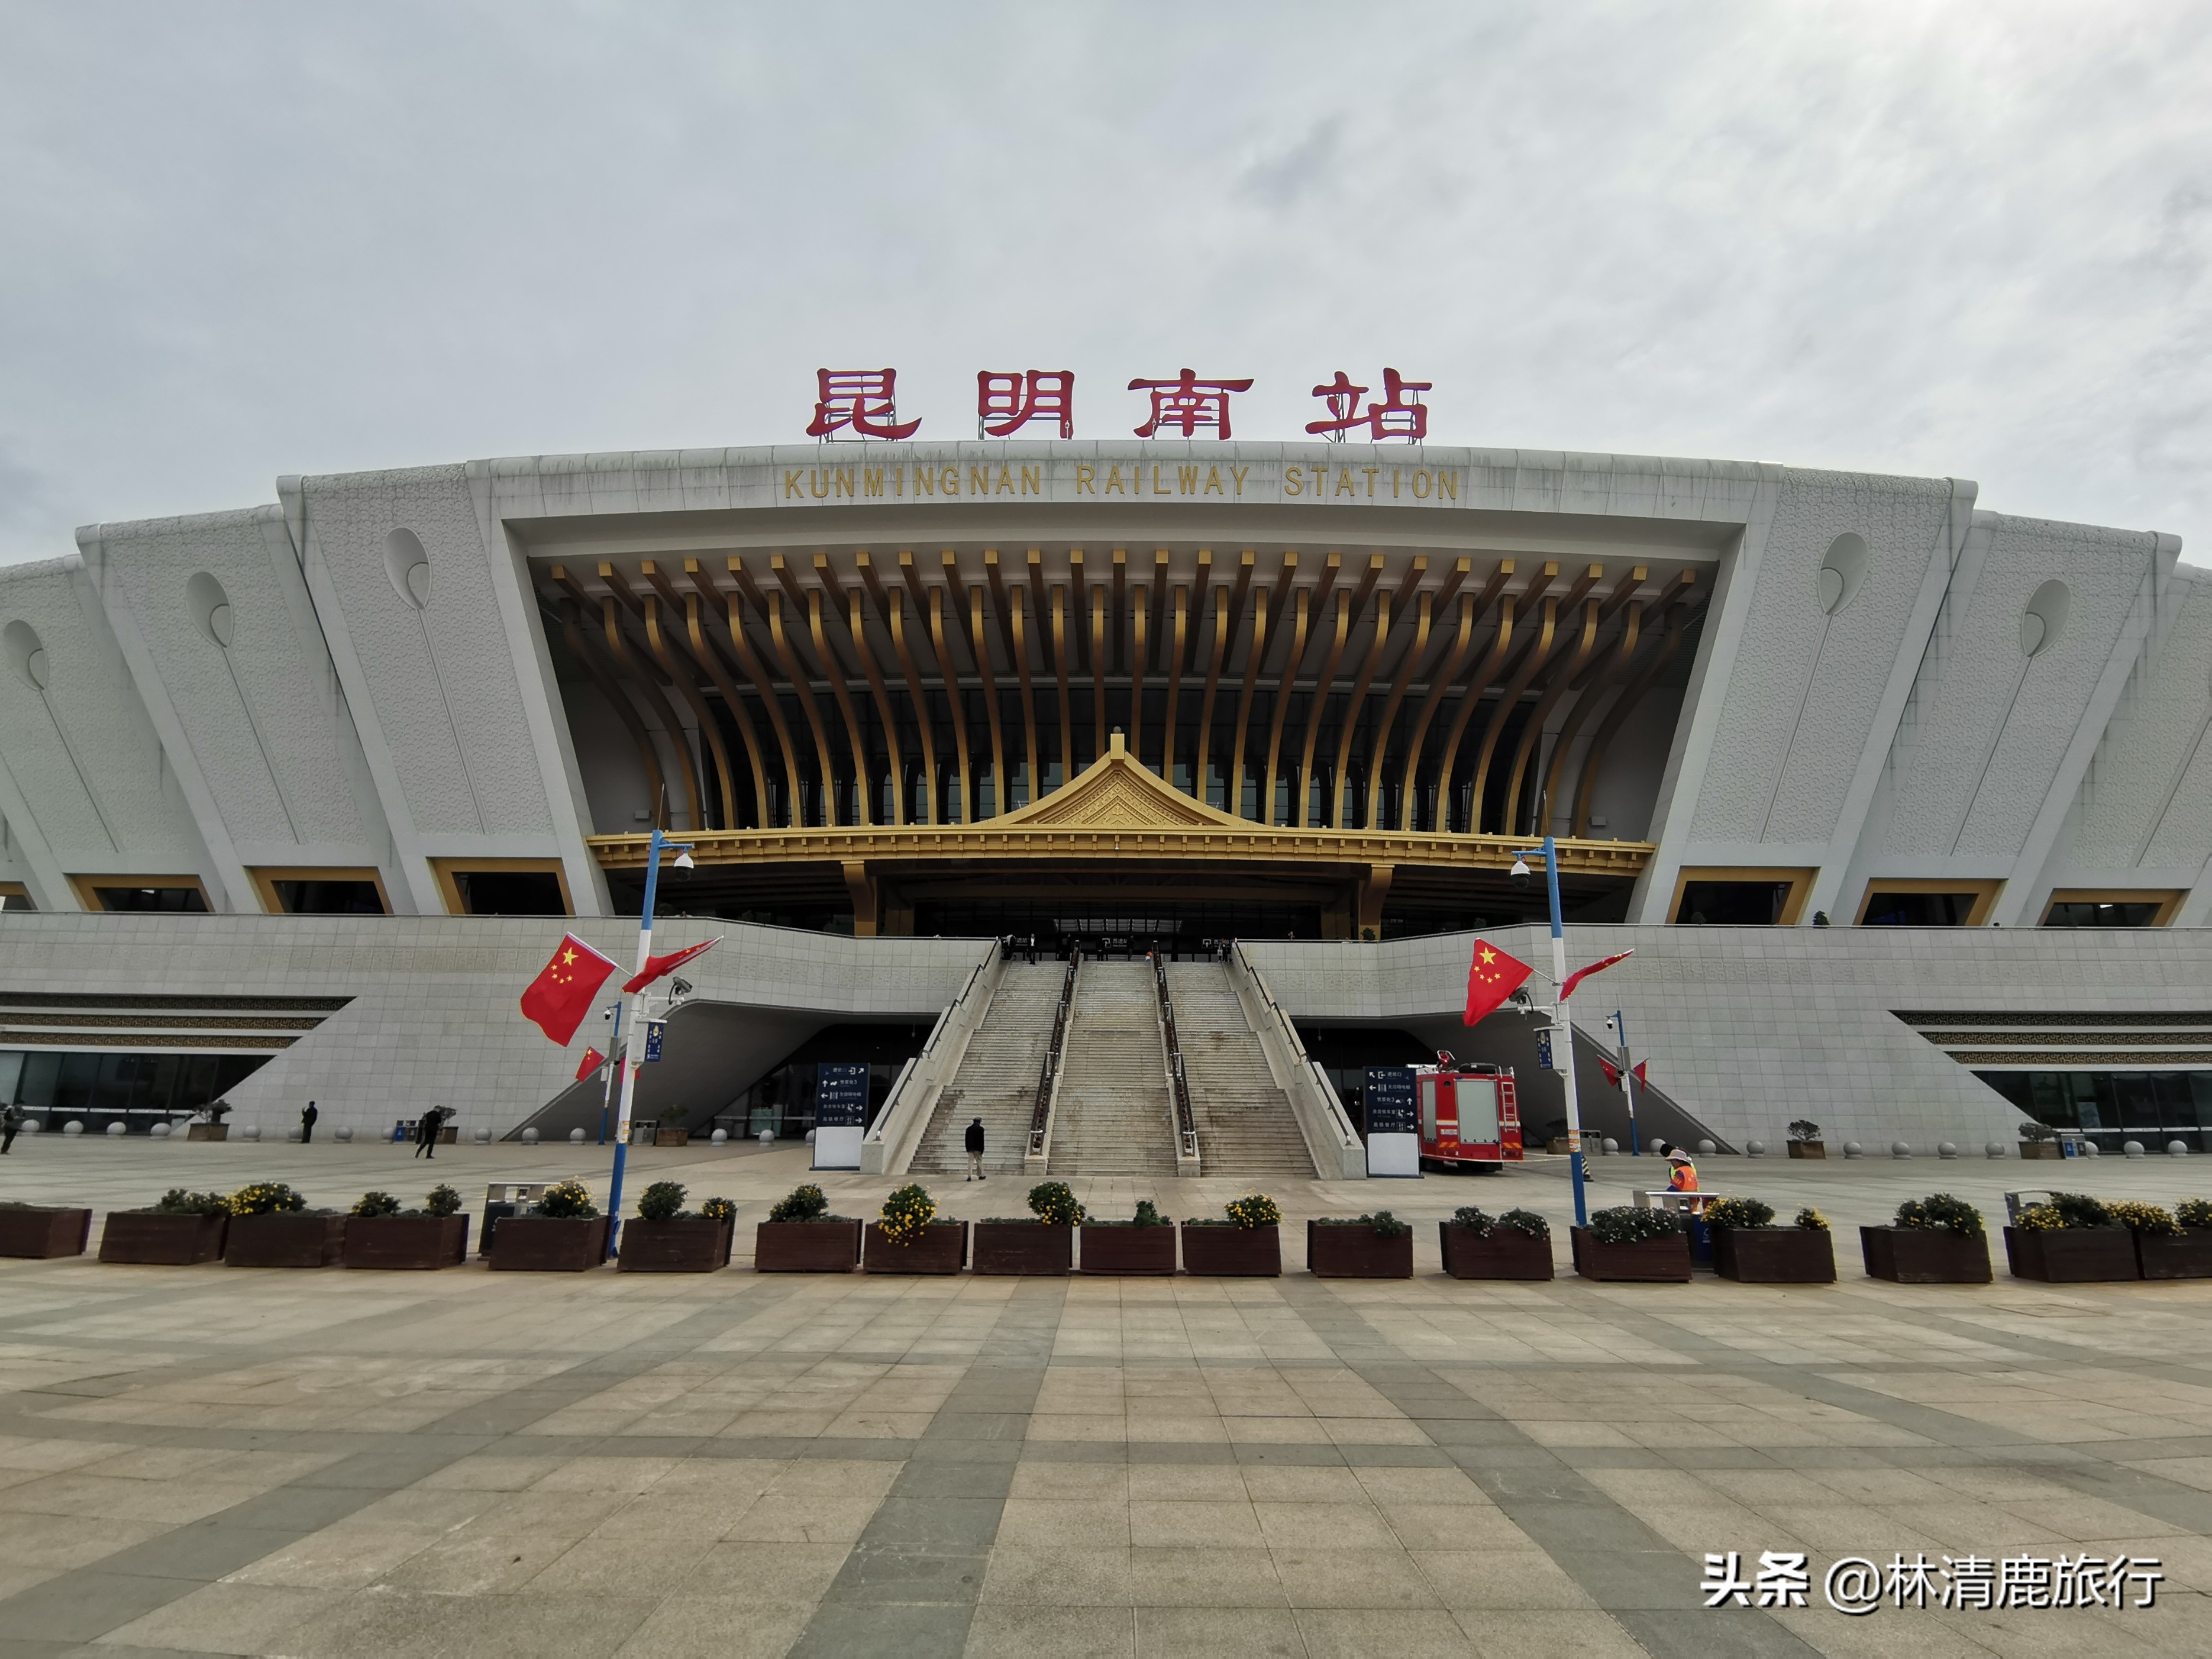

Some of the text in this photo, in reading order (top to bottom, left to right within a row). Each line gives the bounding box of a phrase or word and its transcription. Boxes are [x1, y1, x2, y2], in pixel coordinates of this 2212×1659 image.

[806, 367, 1432, 440] 昆明南站
[784, 465, 1458, 499] KUNMINGNAN RAILWAY STATION
